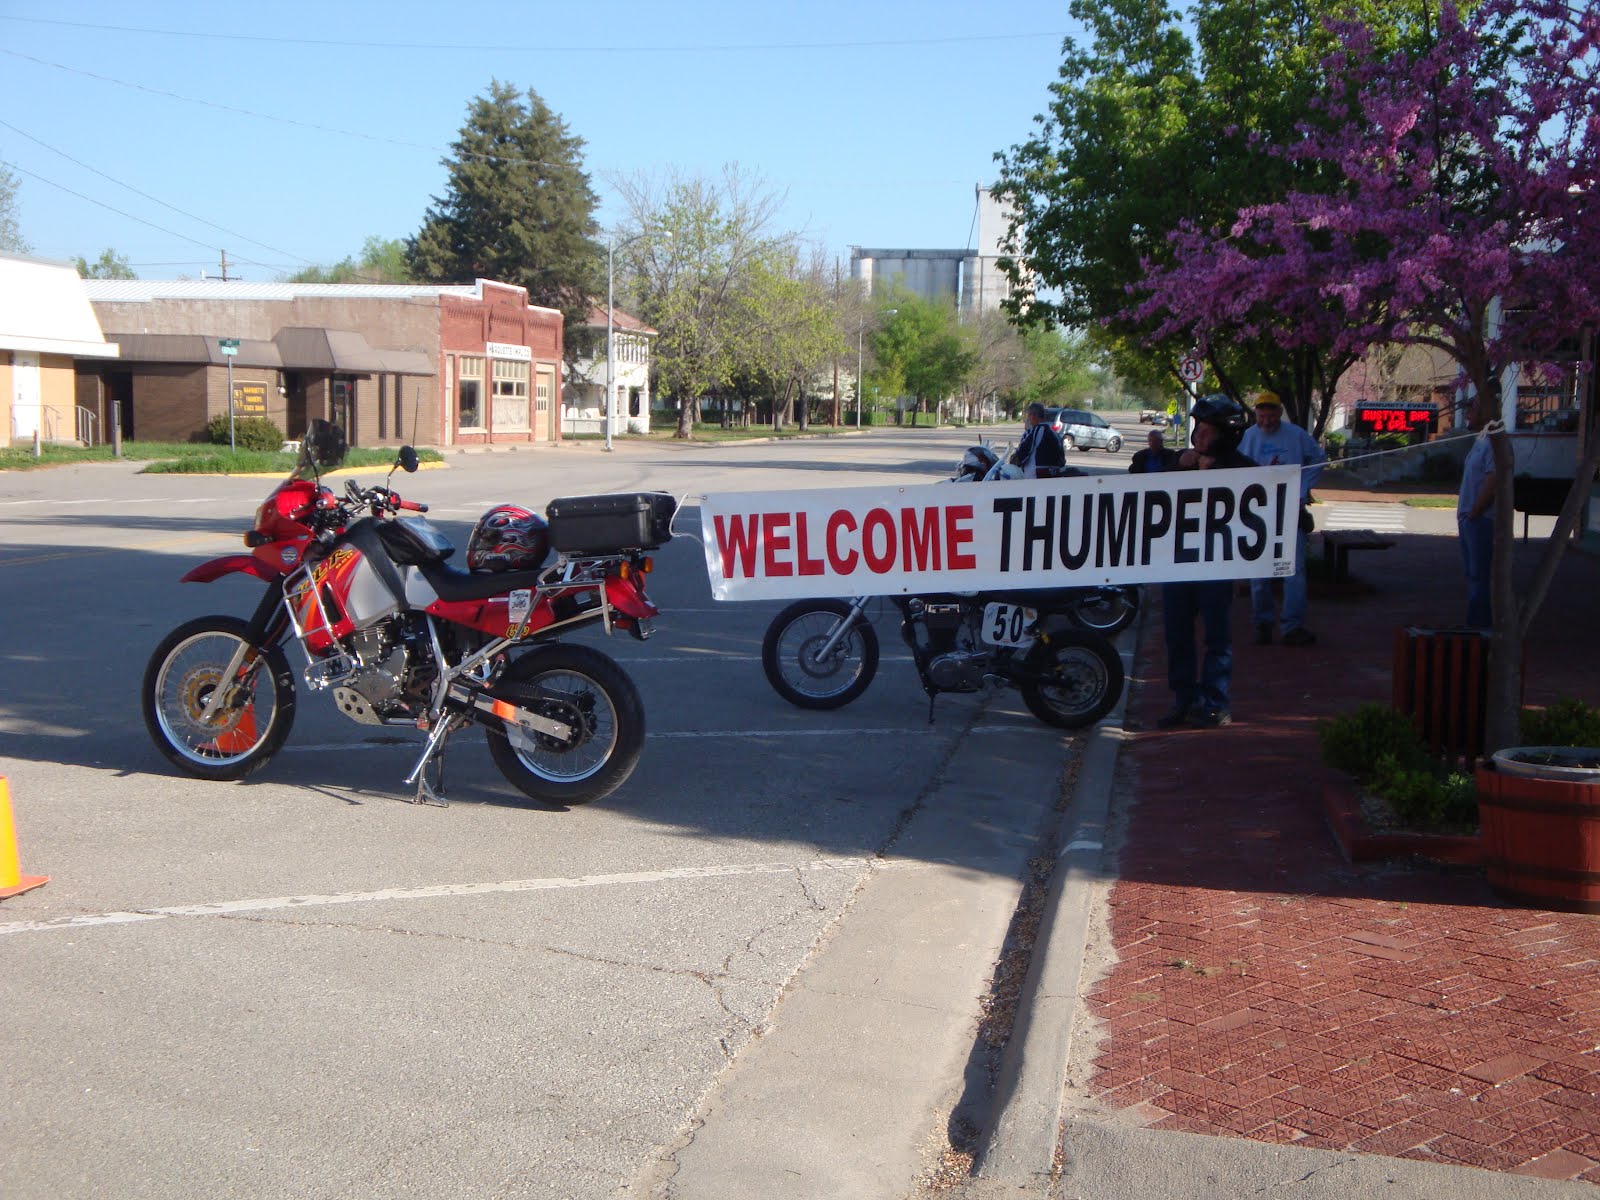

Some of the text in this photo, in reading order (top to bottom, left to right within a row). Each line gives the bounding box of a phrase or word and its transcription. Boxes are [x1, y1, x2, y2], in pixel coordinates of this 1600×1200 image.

[713, 483, 1287, 579] WELCOME THUMPERS!
[992, 605, 1024, 643] 50
